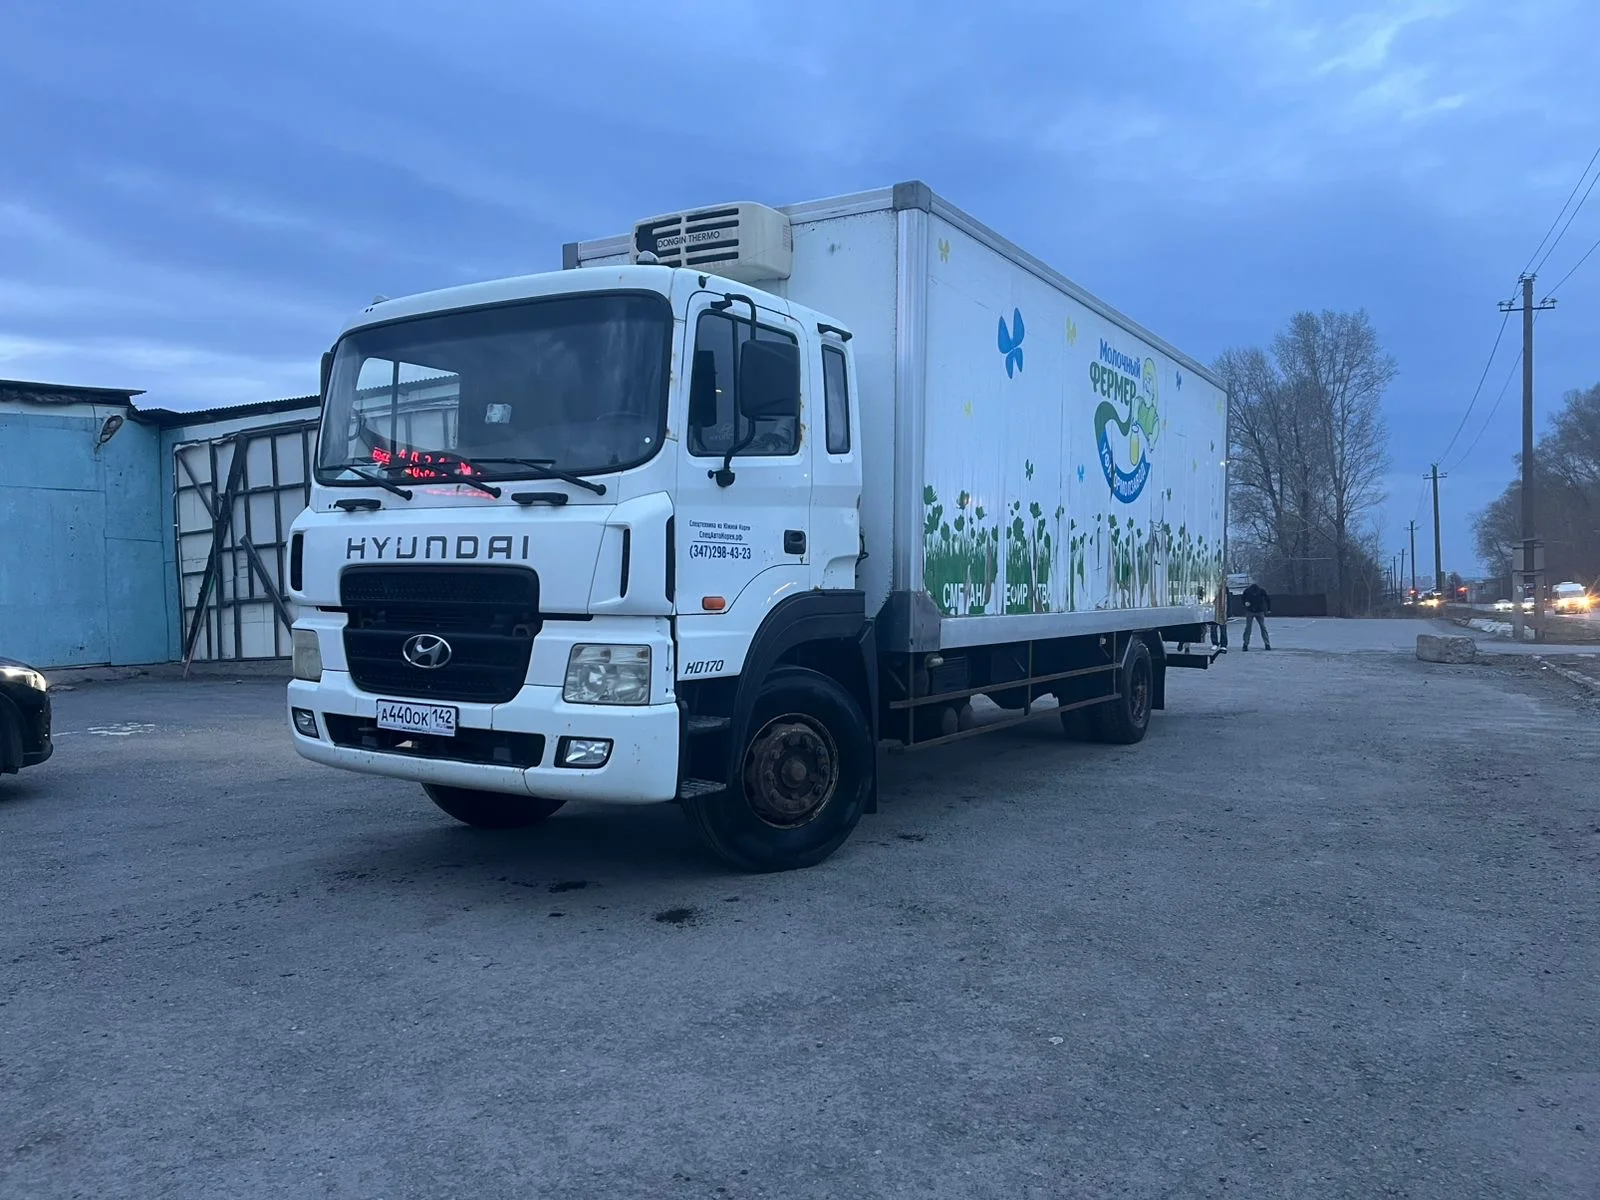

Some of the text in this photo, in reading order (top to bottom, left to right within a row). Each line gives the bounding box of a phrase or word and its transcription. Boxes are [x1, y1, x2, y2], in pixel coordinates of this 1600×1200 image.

[658, 230, 720, 248] DONGIN THERMO
[1090, 361, 1136, 407] ФЕРМЕР
[346, 535, 529, 560] HYUNDAI
[689, 544, 751, 560] (347)298-43-23
[684, 659, 724, 675] HD170
[432, 708, 452, 724] 142
